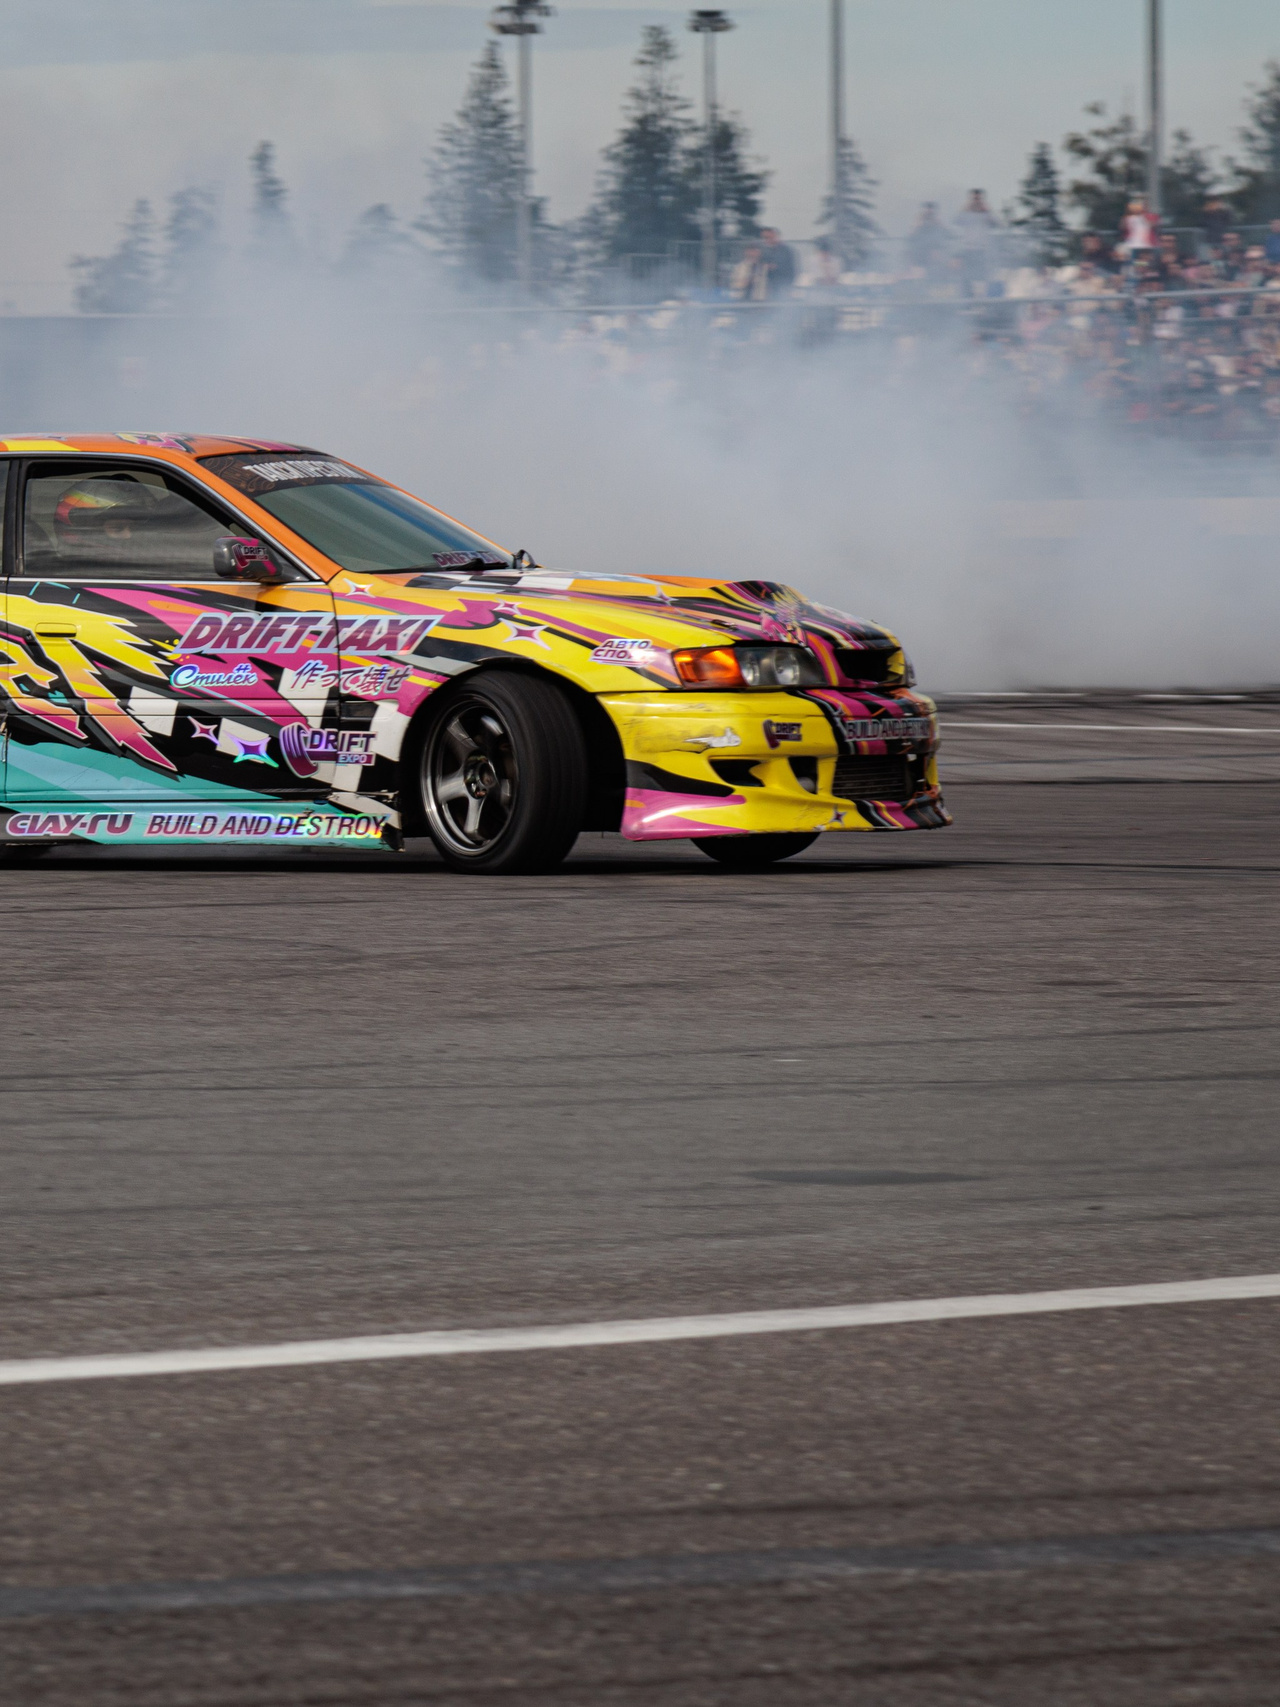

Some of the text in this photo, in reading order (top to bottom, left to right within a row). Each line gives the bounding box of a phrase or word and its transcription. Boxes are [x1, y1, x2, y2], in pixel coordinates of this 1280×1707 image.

[602, 640, 651, 650] АВТО
[309, 730, 376, 752] DRIFT
[339, 753, 368, 764] EXPO
[147, 815, 388, 838] BUILD AND DESTROY
